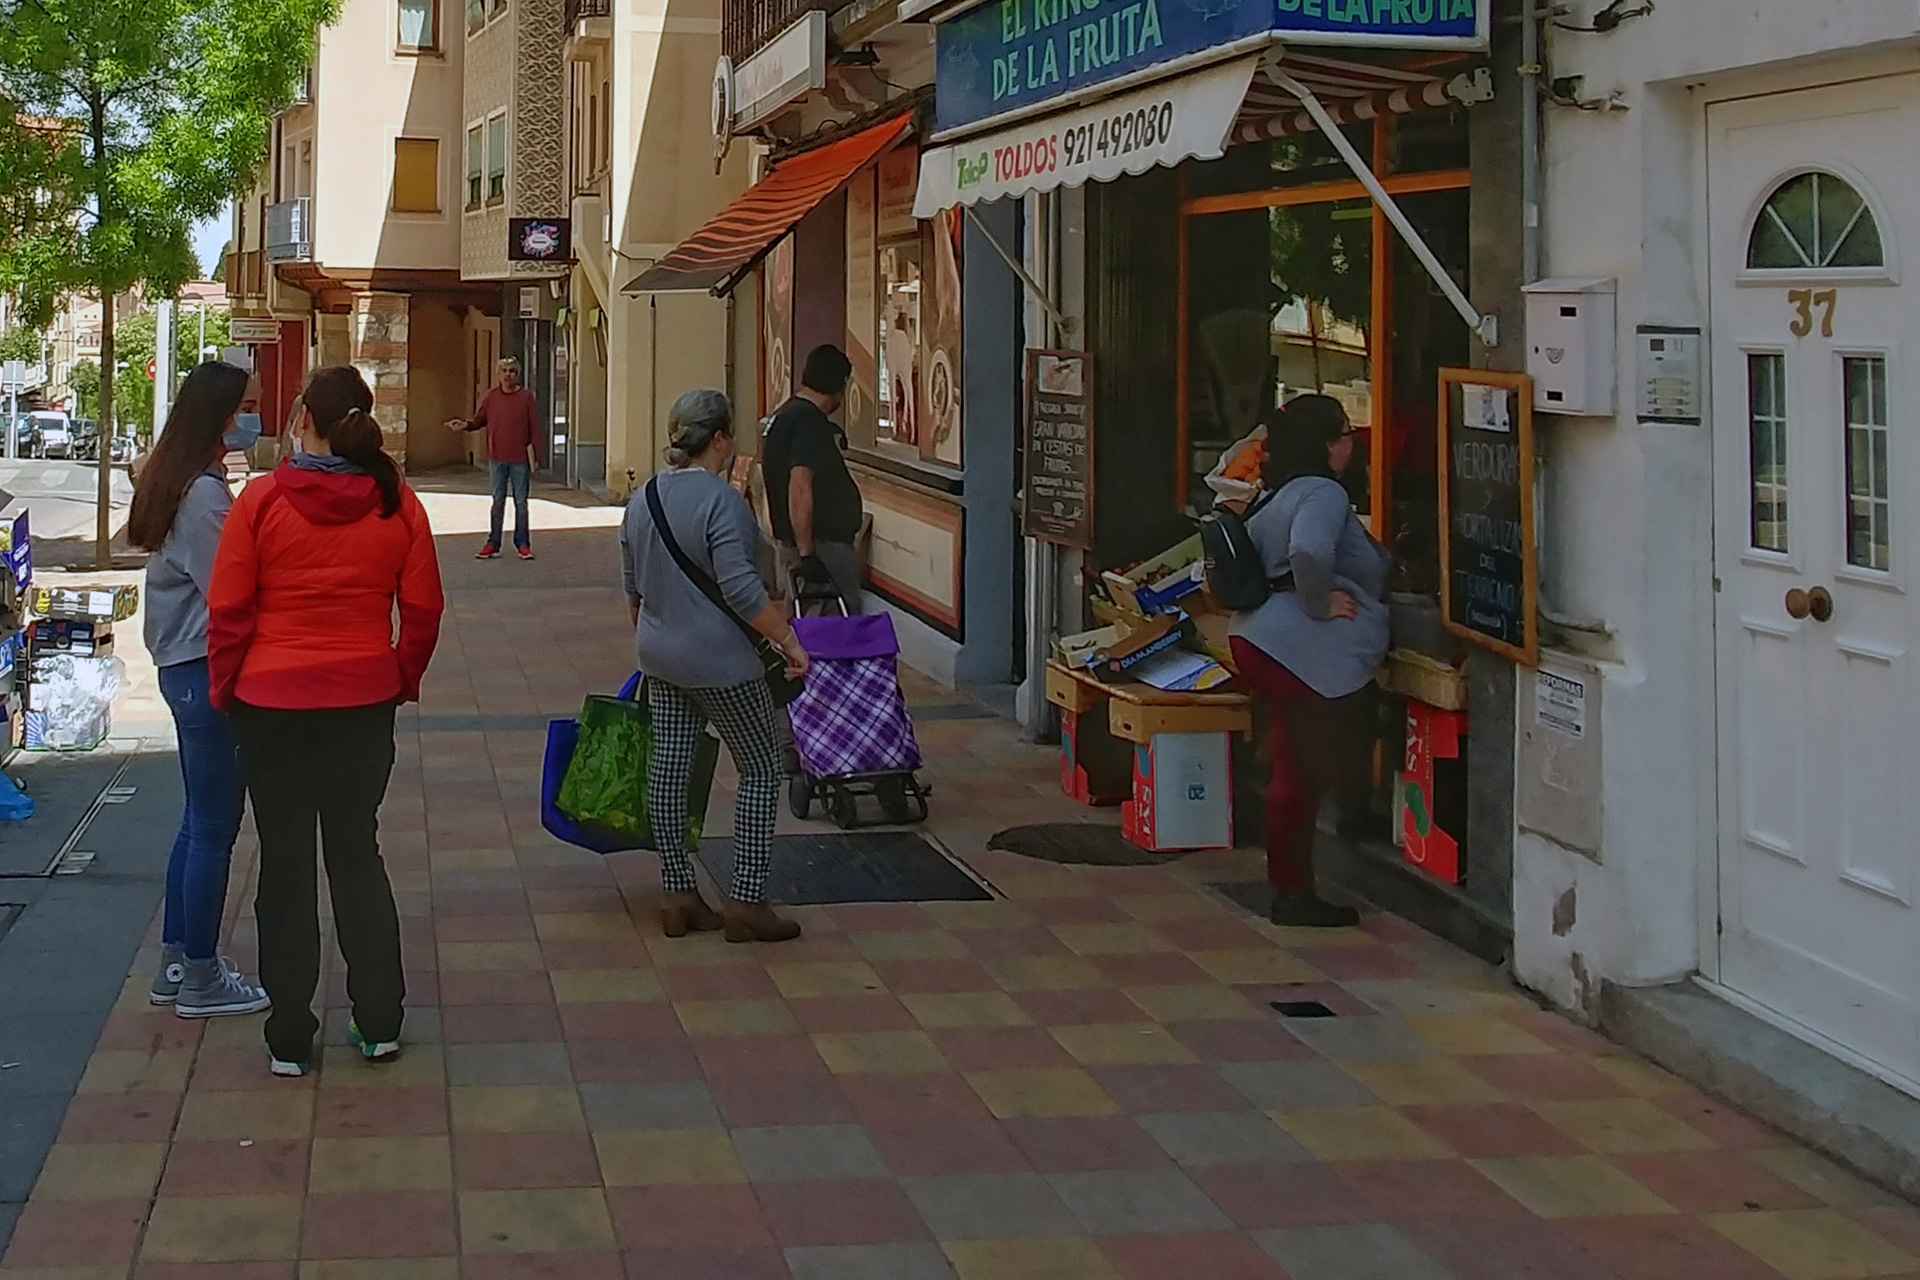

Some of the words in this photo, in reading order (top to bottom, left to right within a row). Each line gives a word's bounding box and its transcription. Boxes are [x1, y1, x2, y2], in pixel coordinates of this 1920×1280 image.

[1002, 0, 1027, 44] EL
[993, 51, 1020, 101] DE
[1027, 38, 1060, 90] LA
[1068, 0, 1163, 78] FRUTA
[994, 134, 1058, 183] TOLDOS
[1787, 288, 1837, 338] 37
